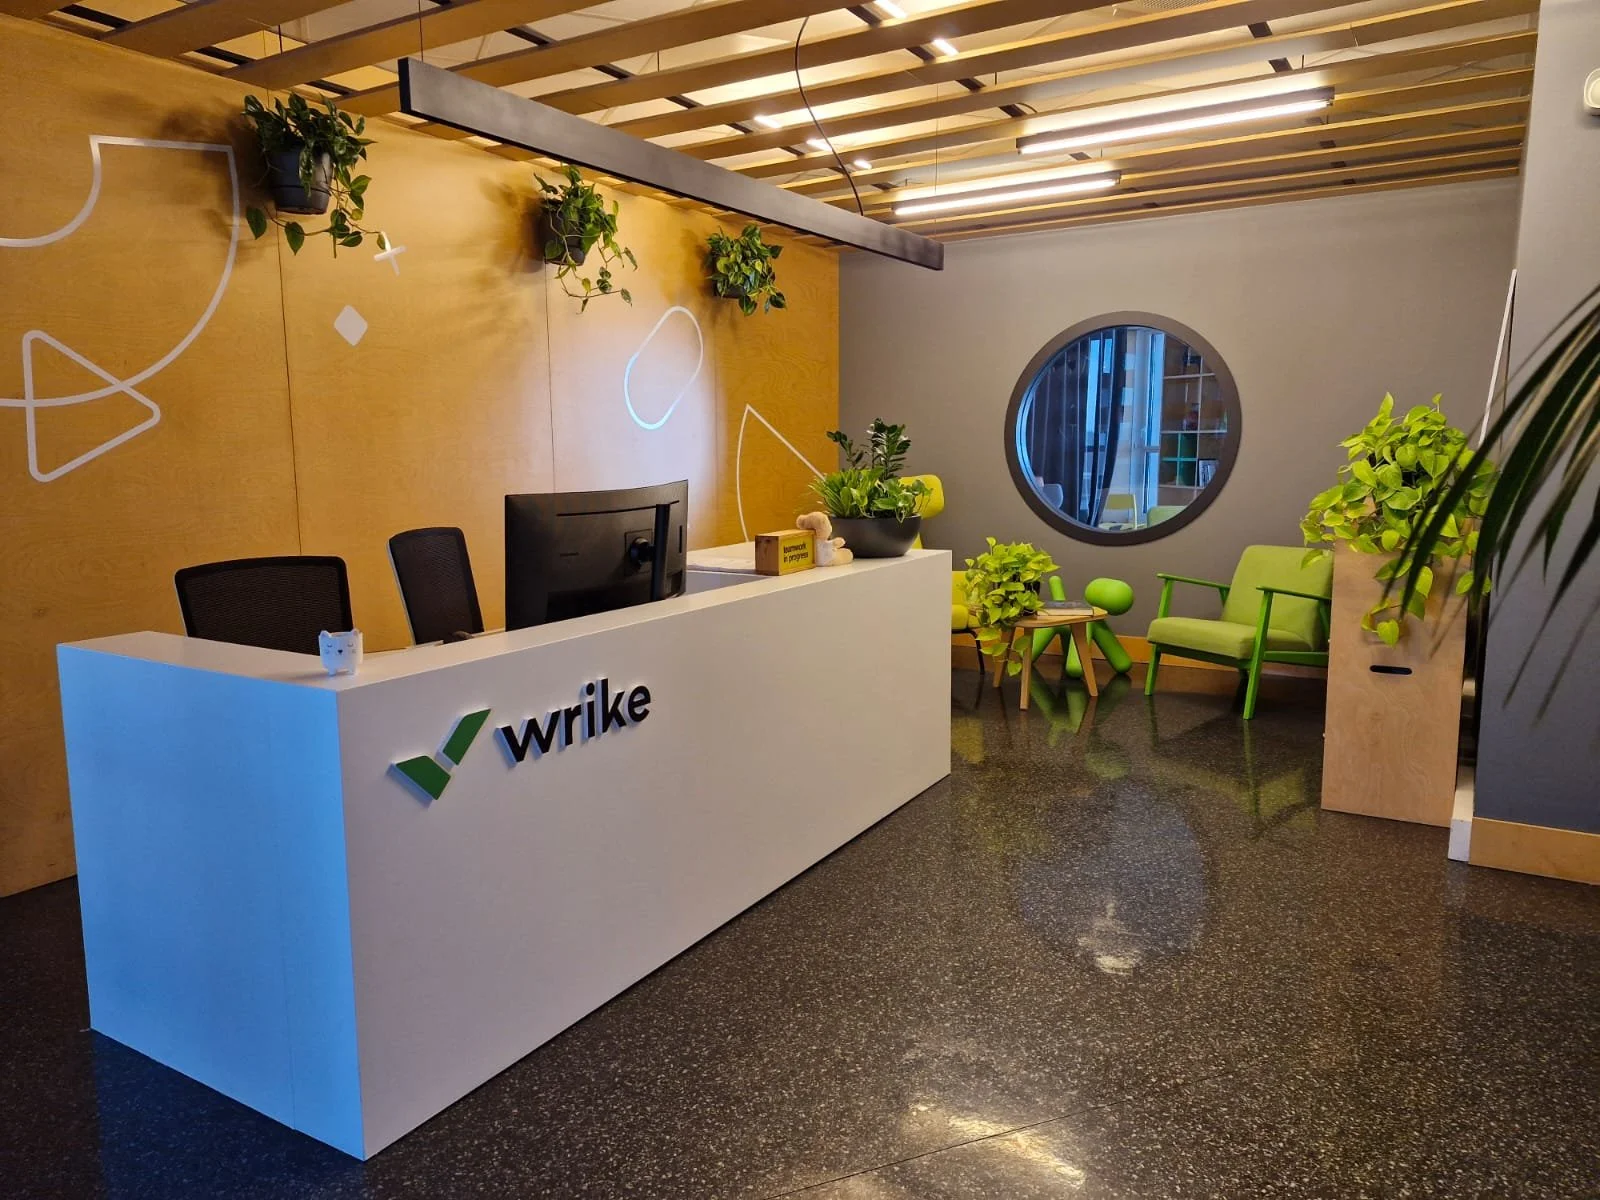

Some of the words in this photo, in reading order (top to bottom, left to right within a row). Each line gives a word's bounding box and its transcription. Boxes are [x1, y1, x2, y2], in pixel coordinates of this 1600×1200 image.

[783, 555, 788, 563] in
[788, 552, 809, 564] progress
[499, 677, 652, 764] wrike
